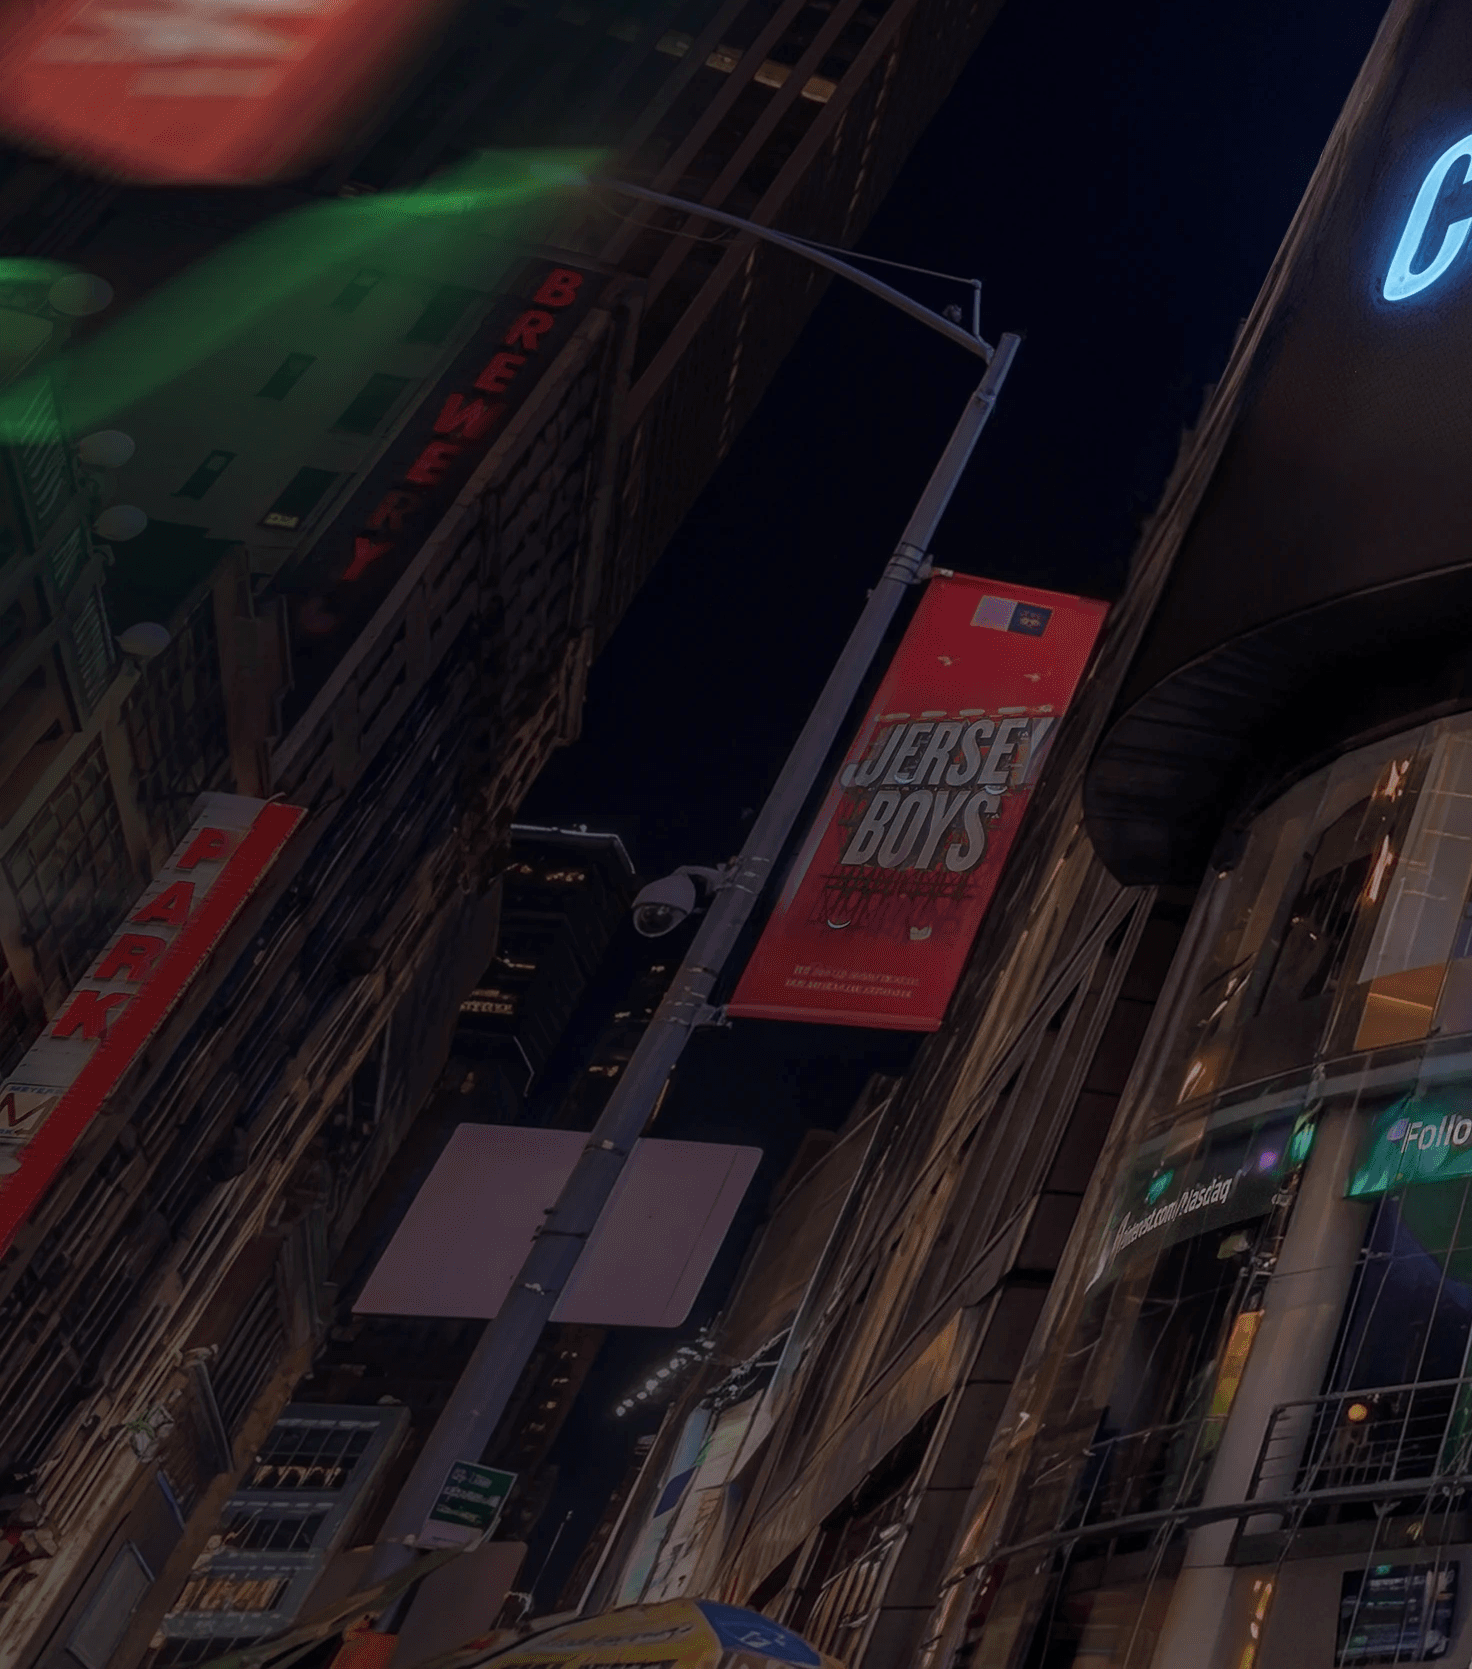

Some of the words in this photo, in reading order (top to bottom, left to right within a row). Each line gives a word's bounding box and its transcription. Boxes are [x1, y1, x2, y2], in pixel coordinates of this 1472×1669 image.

[340, 267, 585, 583] BREWERY
[840, 716, 1060, 789] JERSEY
[840, 788, 1003, 873] BOYS
[49, 826, 233, 1042] PARK
